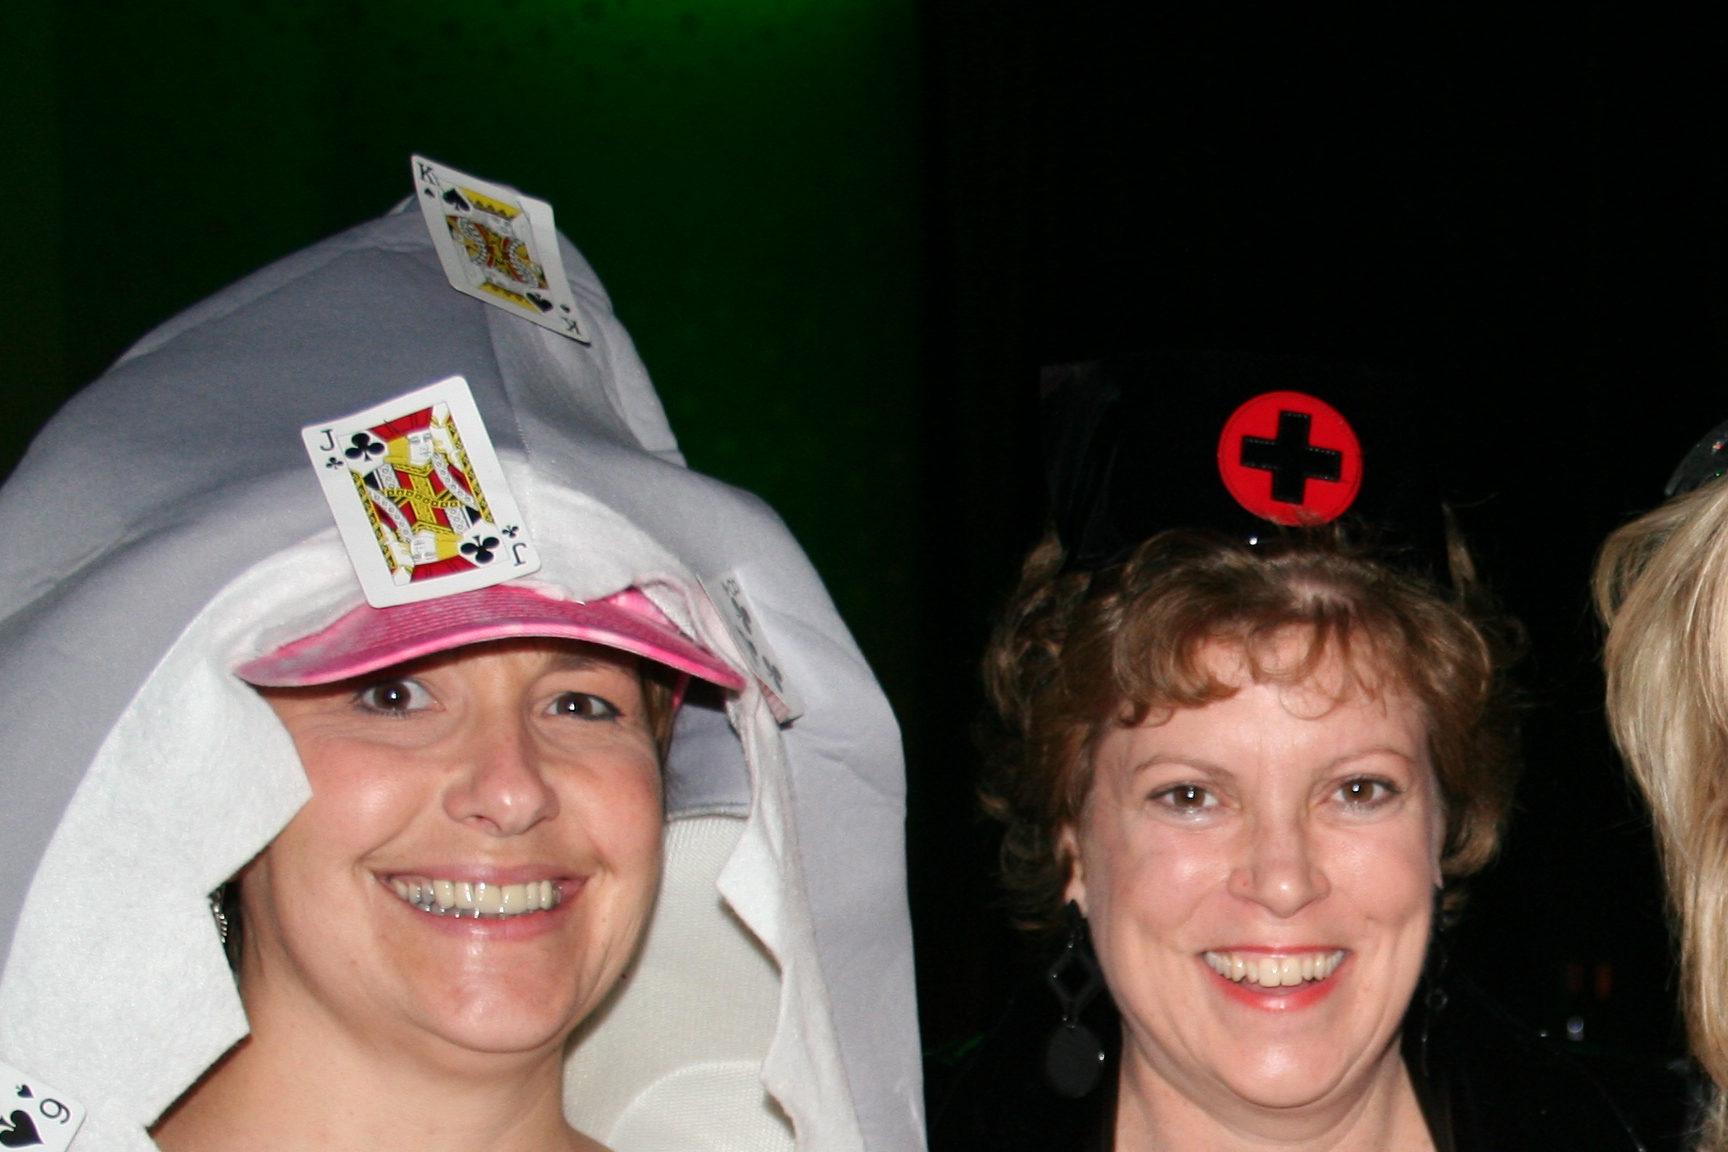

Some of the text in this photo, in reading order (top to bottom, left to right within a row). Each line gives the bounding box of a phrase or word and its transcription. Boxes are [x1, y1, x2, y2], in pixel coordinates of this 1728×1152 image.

[417, 161, 437, 186] K
[560, 315, 581, 336] K
[320, 428, 335, 452] J
[512, 542, 527, 567] J
